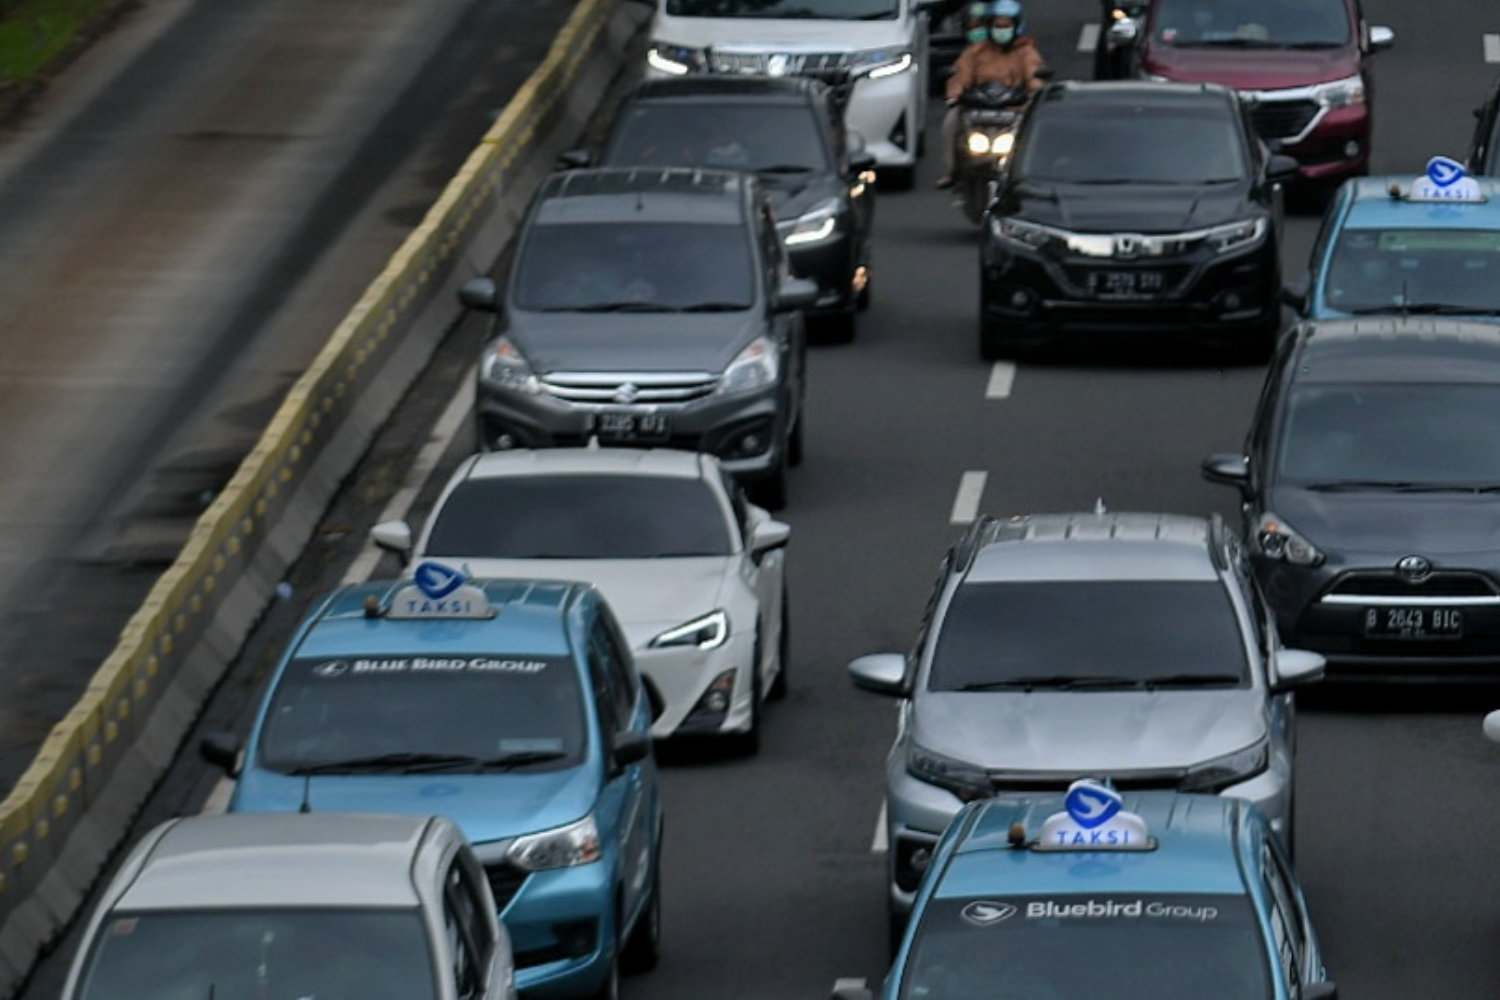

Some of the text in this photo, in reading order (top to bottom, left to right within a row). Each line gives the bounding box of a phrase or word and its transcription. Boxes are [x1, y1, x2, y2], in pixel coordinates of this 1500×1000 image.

[1423, 187, 1471, 198] TAKSI
[407, 601, 471, 612] TAKSI
[1388, 608, 1423, 628] 2643
[354, 658, 547, 673] BLUE BIRD GROUP
[1056, 830, 1130, 845] TAKSI
[1026, 900, 1219, 922] Bluebird Group
